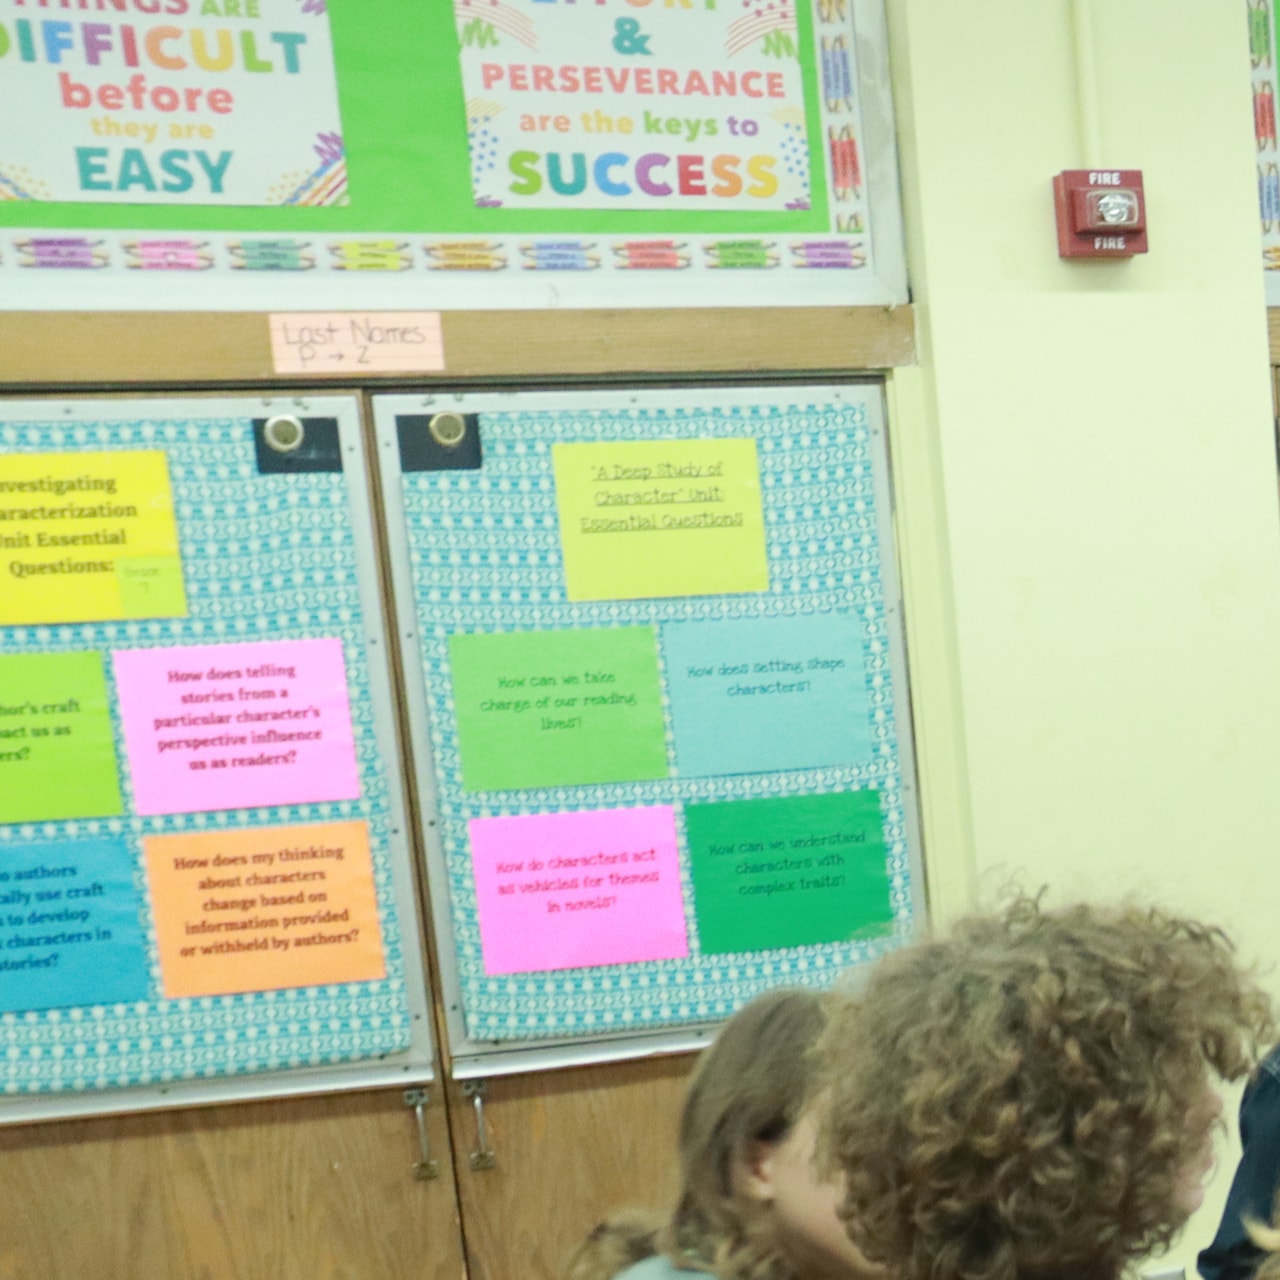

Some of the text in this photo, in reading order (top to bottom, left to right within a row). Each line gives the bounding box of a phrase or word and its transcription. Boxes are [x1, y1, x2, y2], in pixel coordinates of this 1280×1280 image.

[611, 16, 653, 55] &
[481, 63, 786, 98] PERSEVERANCE
[58, 71, 235, 115] before
[90, 116, 215, 143] they are
[519, 109, 760, 142] are the keys to
[74, 146, 234, 194] EASY
[508, 150, 780, 198] SUCCESS
[1088, 172, 1121, 186] FIRE
[1093, 236, 1126, 250] FIRE
[282, 318, 427, 346] Last Names
[356, 346, 370, 364] Z
[611, 464, 652, 481] Deep
[656, 460, 703, 478] Study
[706, 461, 724, 477] of
[580, 511, 744, 534] Essential Questions
[36, 529, 127, 547] Essential
[9, 558, 115, 580] Questions:
[168, 664, 296, 683] How does telling
[181, 687, 289, 704] stories from a
[154, 705, 321, 731] particular character's
[158, 729, 322, 753] perspective influence
[189, 750, 297, 770] us as readers?
[173, 846, 345, 871] How does my thinking
[198, 870, 326, 892] about characters
[202, 891, 328, 912] change based on
[184, 909, 350, 936] information provided
[179, 928, 360, 958] or withheld by authors?
